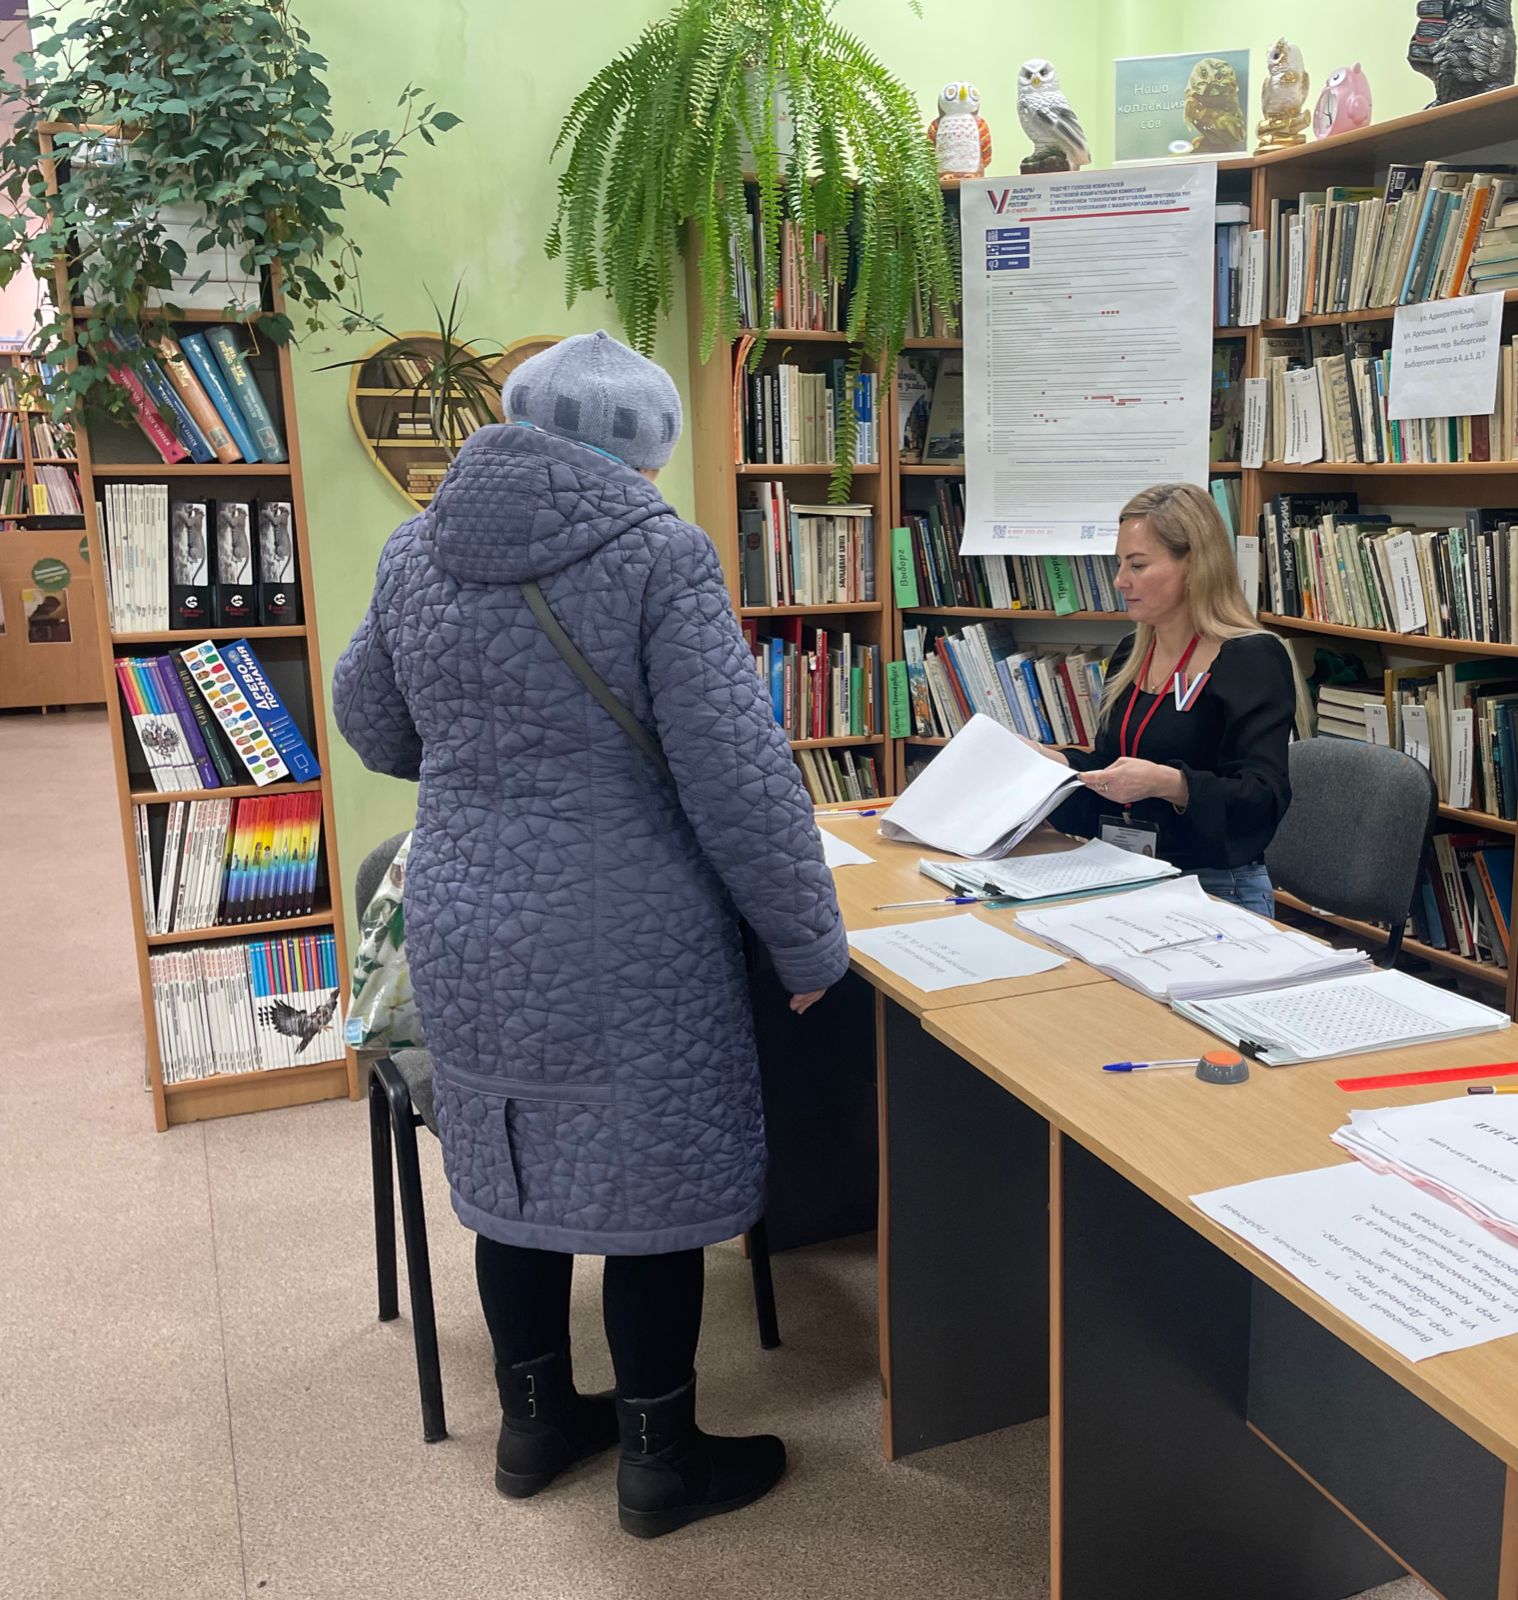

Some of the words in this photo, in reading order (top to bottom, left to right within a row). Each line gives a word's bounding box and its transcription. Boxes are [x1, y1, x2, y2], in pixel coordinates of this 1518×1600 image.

[1134, 83, 1168, 95] Наша
[1118, 100, 1184, 113] коллекция
[1140, 120, 1160, 129] сов
[1460, 320, 1488, 330] Береговая
[898, 550, 909, 586] Выборг
[1284, 549, 1293, 571] МИР
[236, 646, 279, 708] ПОЗНАНИЯ
[237, 664, 271, 710] ДРЕВО
[180, 670, 197, 699] ЦВЕТЫ
[195, 703, 207, 726] МИРА
[1410, 1212, 1456, 1238] Полевая
[1417, 1234, 1470, 1264] Пляжный
[1459, 1237, 1475, 1248] ул.
[1324, 1268, 1342, 1280] ул.
[1340, 1246, 1390, 1274] Зеленый
[1379, 1248, 1472, 1306] Краснофлотский,
[1411, 1248, 1499, 1302] Комсомольская
[1375, 1288, 1426, 1318] Дачный
[1391, 1272, 1458, 1318] Загородная,
[1368, 1303, 1433, 1343] Вишневый
[1460, 1317, 1479, 1331] ул.
[1475, 1305, 1500, 1323] пер.
